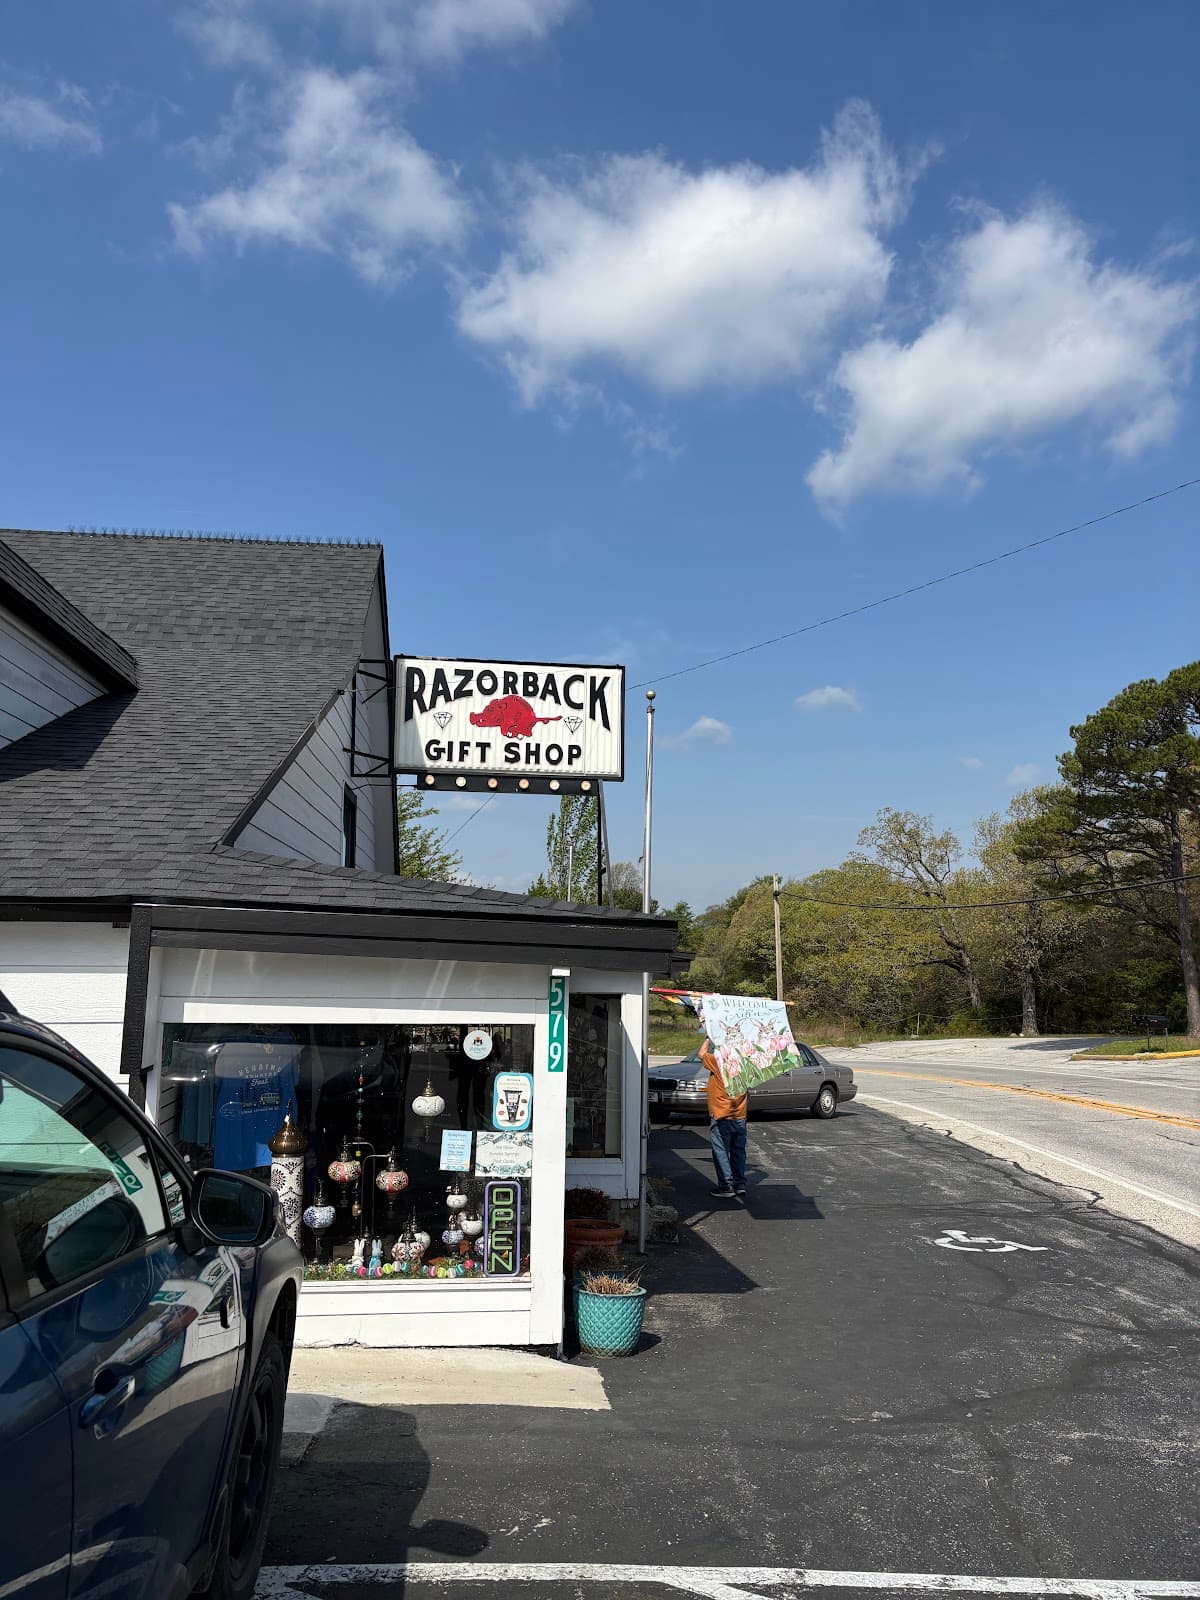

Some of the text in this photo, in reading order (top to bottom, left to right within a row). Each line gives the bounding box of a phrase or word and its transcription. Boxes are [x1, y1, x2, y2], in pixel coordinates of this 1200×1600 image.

[404, 666, 611, 732] RAZORBACK
[425, 739, 582, 766] GIFT SHOP
[550, 978, 563, 1071] 579
[491, 1187, 515, 1273] OPEN
